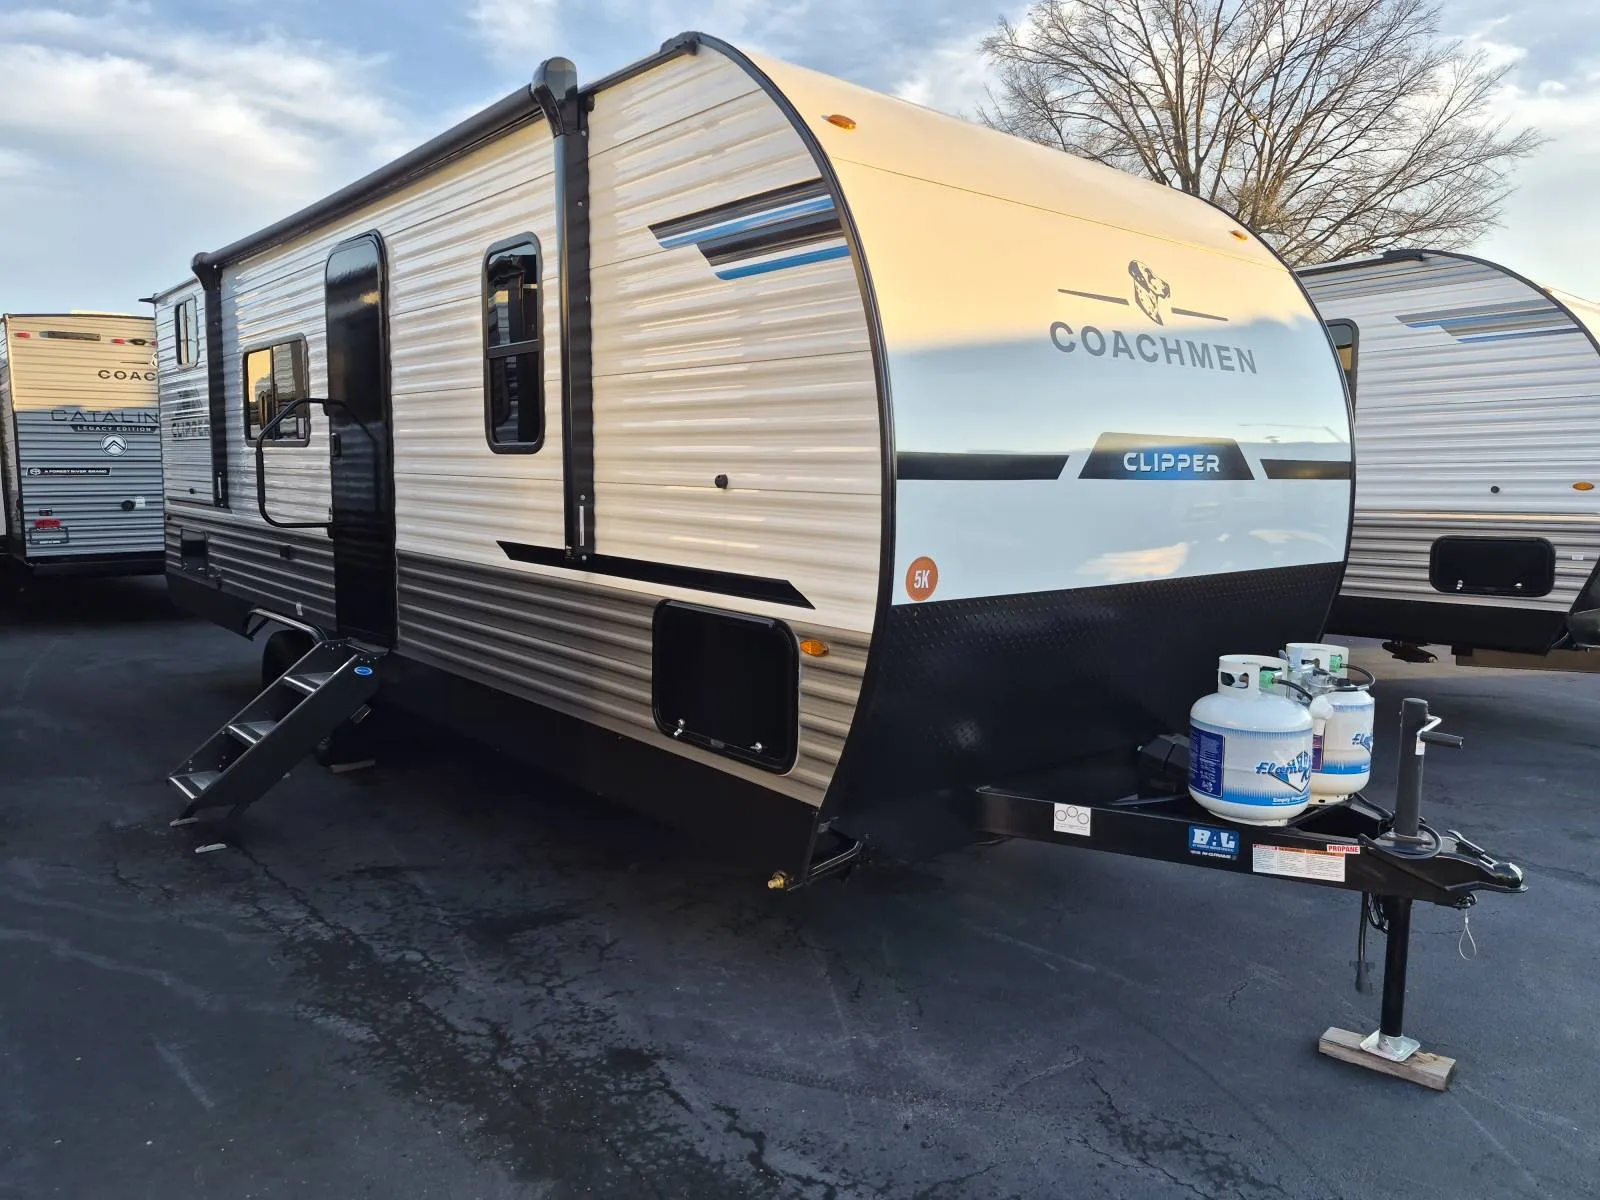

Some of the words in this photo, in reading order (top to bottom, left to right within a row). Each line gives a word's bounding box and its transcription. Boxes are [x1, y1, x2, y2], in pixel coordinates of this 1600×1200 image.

[1049, 321, 1257, 374] COACHMEN
[1123, 452, 1220, 472] CLIPPER
[914, 569, 930, 589] 5K
[1328, 845, 1359, 853] PROPANE
